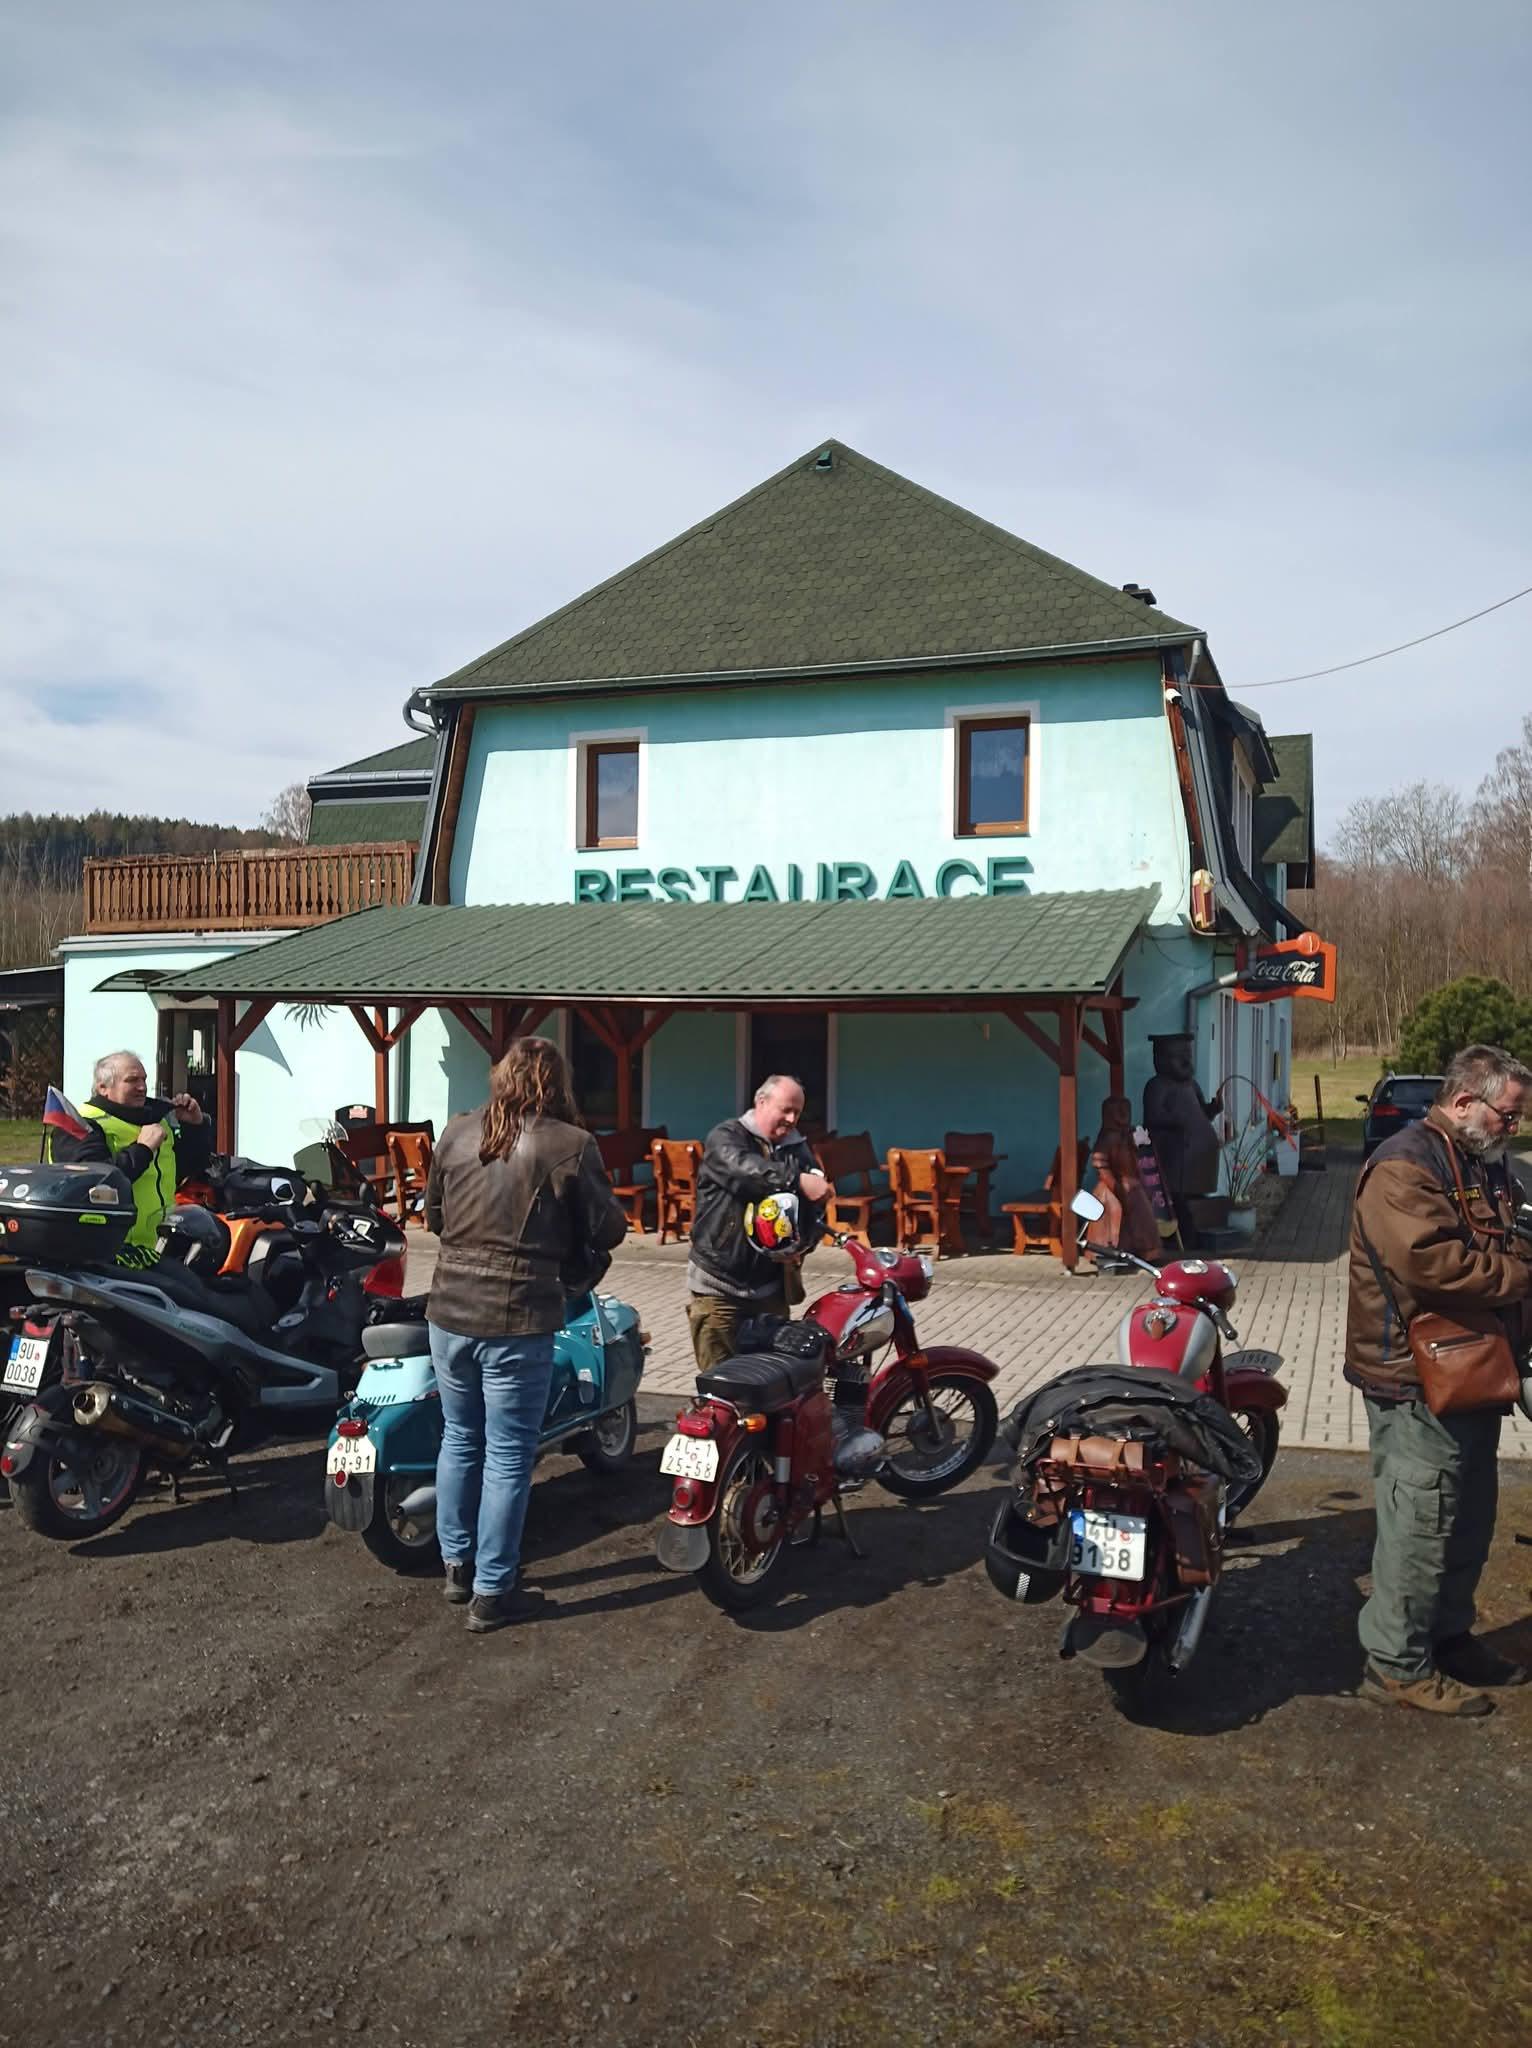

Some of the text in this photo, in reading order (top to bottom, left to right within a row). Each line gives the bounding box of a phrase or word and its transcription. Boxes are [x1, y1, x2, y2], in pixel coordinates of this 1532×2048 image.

[574, 856, 1030, 904] RESTAURACE
[19, 1342, 35, 1360] 9U
[6, 1363, 37, 1383] 0038
[345, 1438, 360, 1454] DC
[333, 1455, 371, 1472] 19-91
[666, 1455, 712, 1479] 25-58
[1071, 1543, 1131, 1571] 9158
